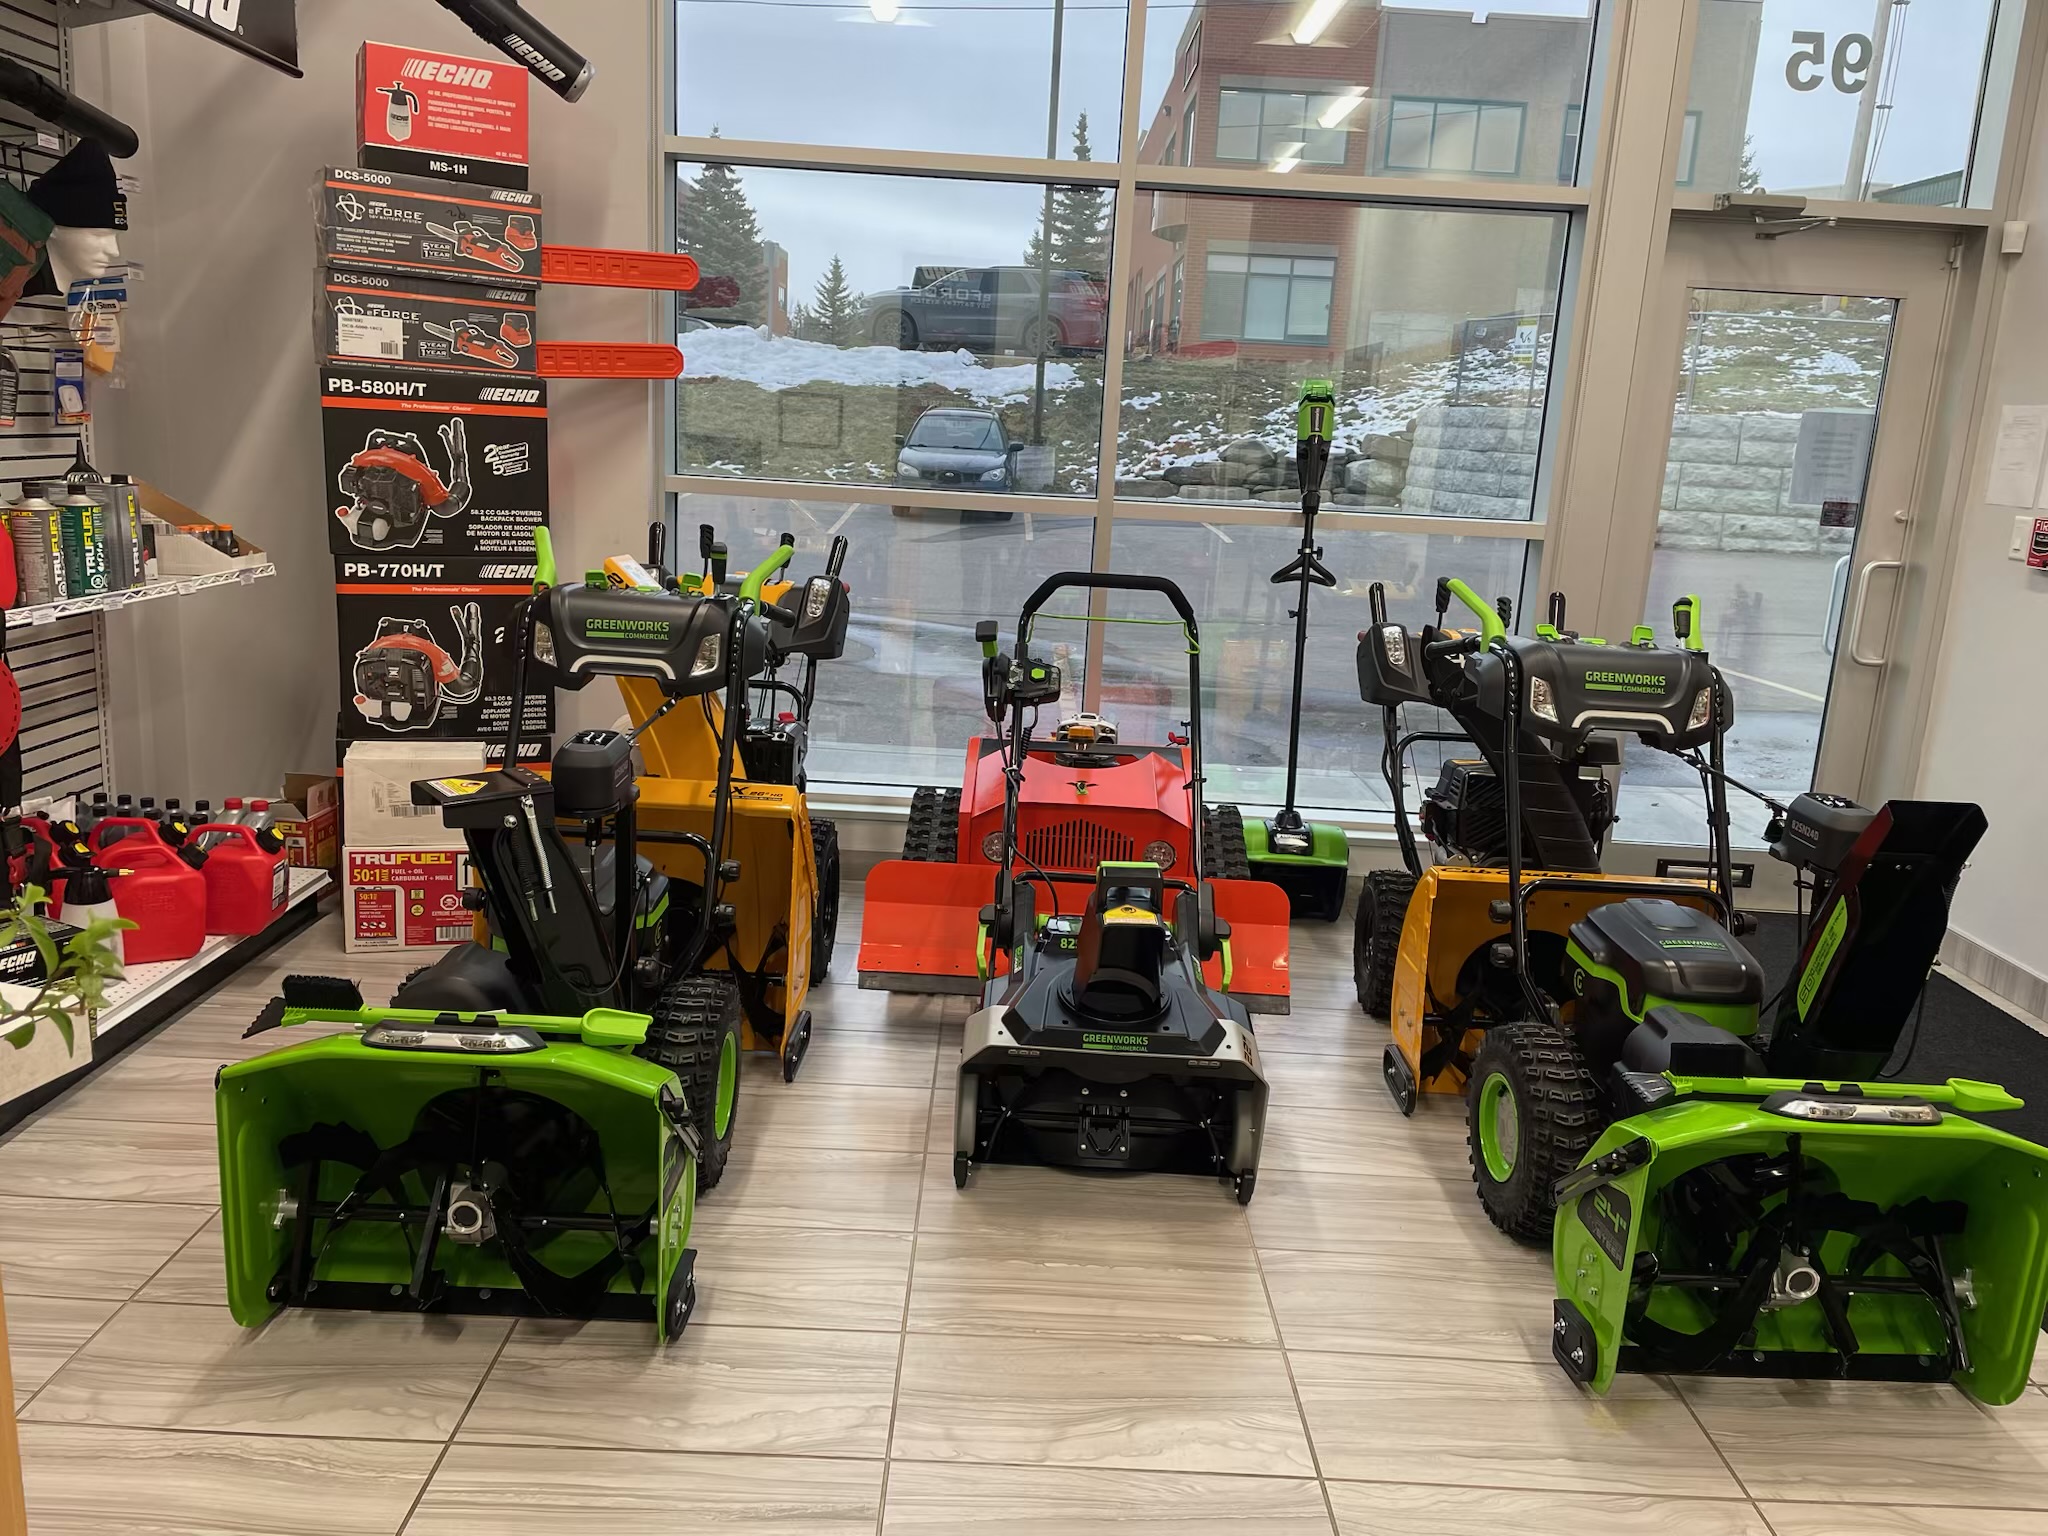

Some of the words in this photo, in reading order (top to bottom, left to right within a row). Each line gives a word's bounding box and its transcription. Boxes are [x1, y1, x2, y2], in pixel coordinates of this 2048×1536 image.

[504, 33, 566, 82] ECHO
[401, 58, 493, 89] ECHO
[430, 161, 468, 174] MS-1H
[335, 169, 392, 185] DCS-5000
[490, 190, 533, 204] ECHO
[369, 207, 422, 220] eFORCE
[334, 274, 389, 287] DCS-5000
[486, 290, 527, 302] ECHO
[328, 378, 427, 397] PB-580H/T
[478, 387, 540, 403] ECHO
[484, 444, 499, 463] 2
[2036, 520, 2048, 532] FIR
[128, 491, 140, 577] TRUFUEL
[49, 511, 63, 585] TRUFUEL
[82, 507, 96, 576] TRUFUEL
[344, 563, 444, 578] PB-770H/T
[586, 619, 670, 632] GREENWORKS
[625, 632, 669, 640] COMMERCIAL
[1585, 671, 1666, 686] GREENWORKS
[1622, 686, 1665, 694] COMMERCIAL
[351, 853, 452, 865] TRUFUEL
[353, 869, 380, 882] 50:1
[0, 950, 37, 970] ECHO
[1083, 1034, 1148, 1045] GREENWORKS
